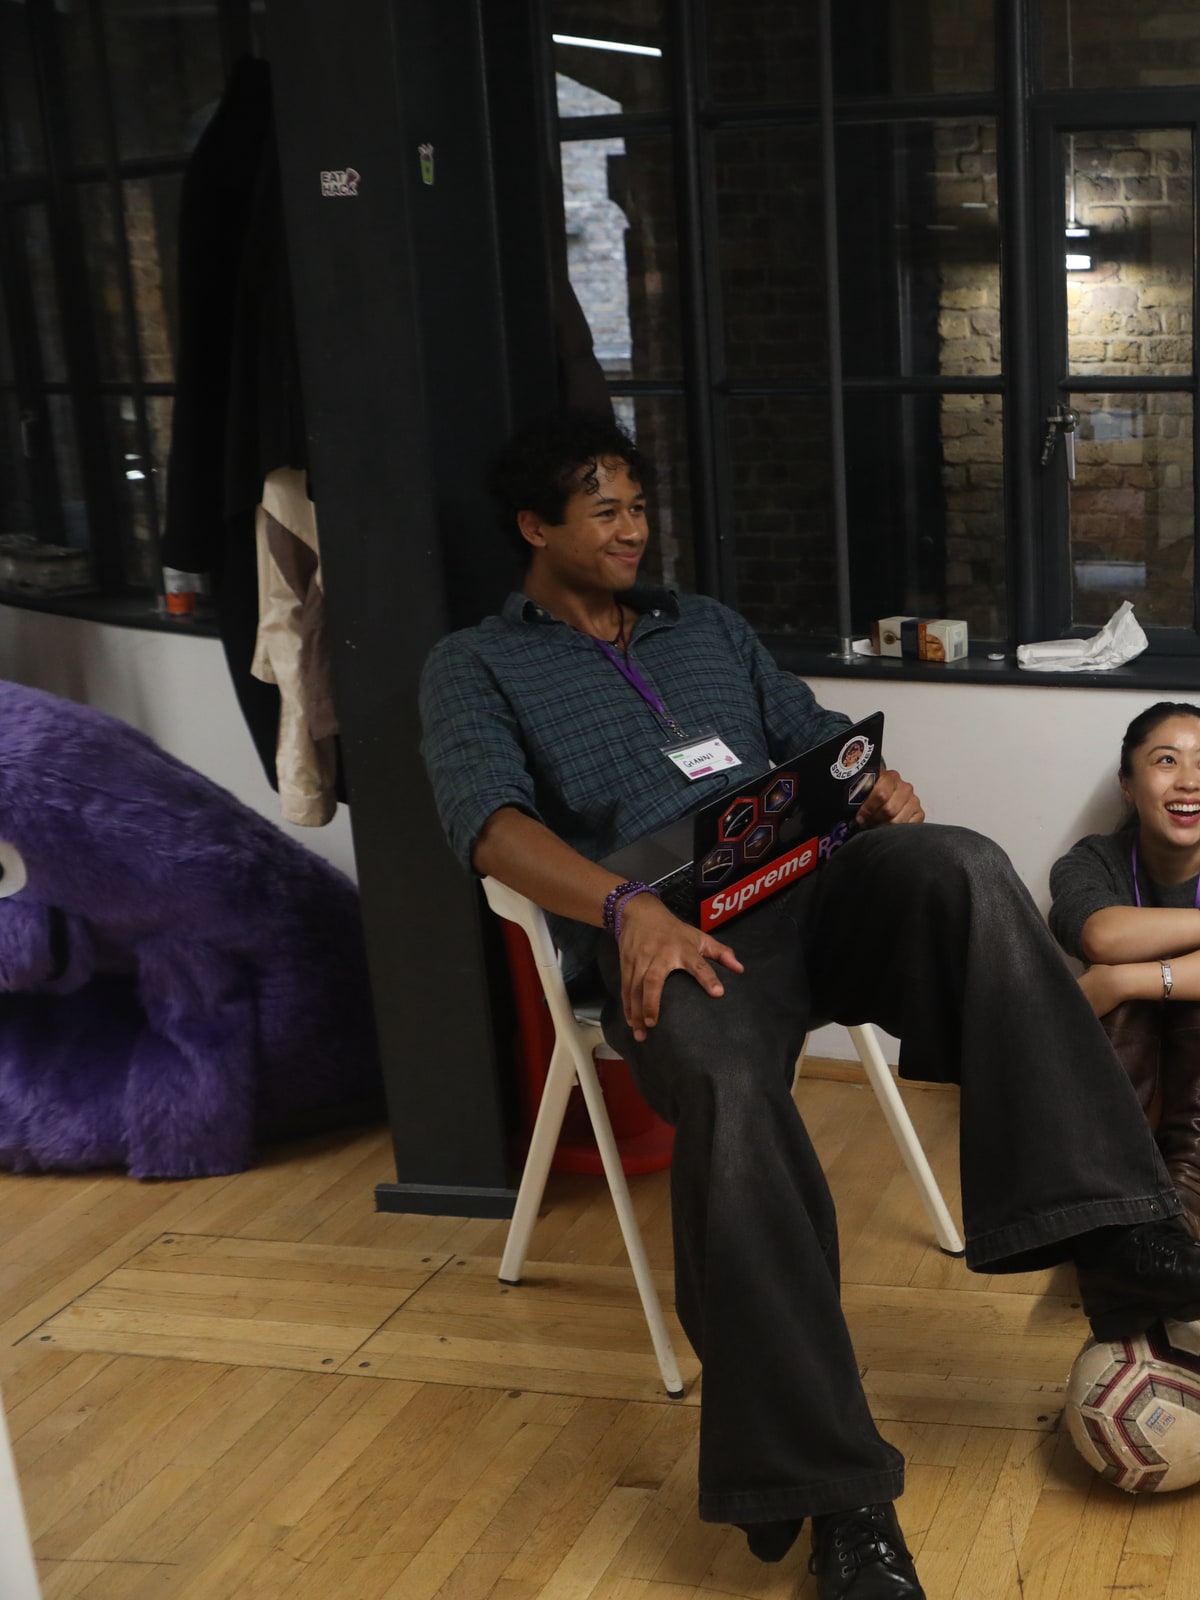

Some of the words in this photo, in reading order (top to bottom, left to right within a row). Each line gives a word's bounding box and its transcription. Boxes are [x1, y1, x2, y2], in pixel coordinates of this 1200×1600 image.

[321, 171, 346, 183] EAT
[321, 183, 358, 196] HACK
[831, 763, 853, 779] SPACE
[709, 849, 813, 920] Supreme
